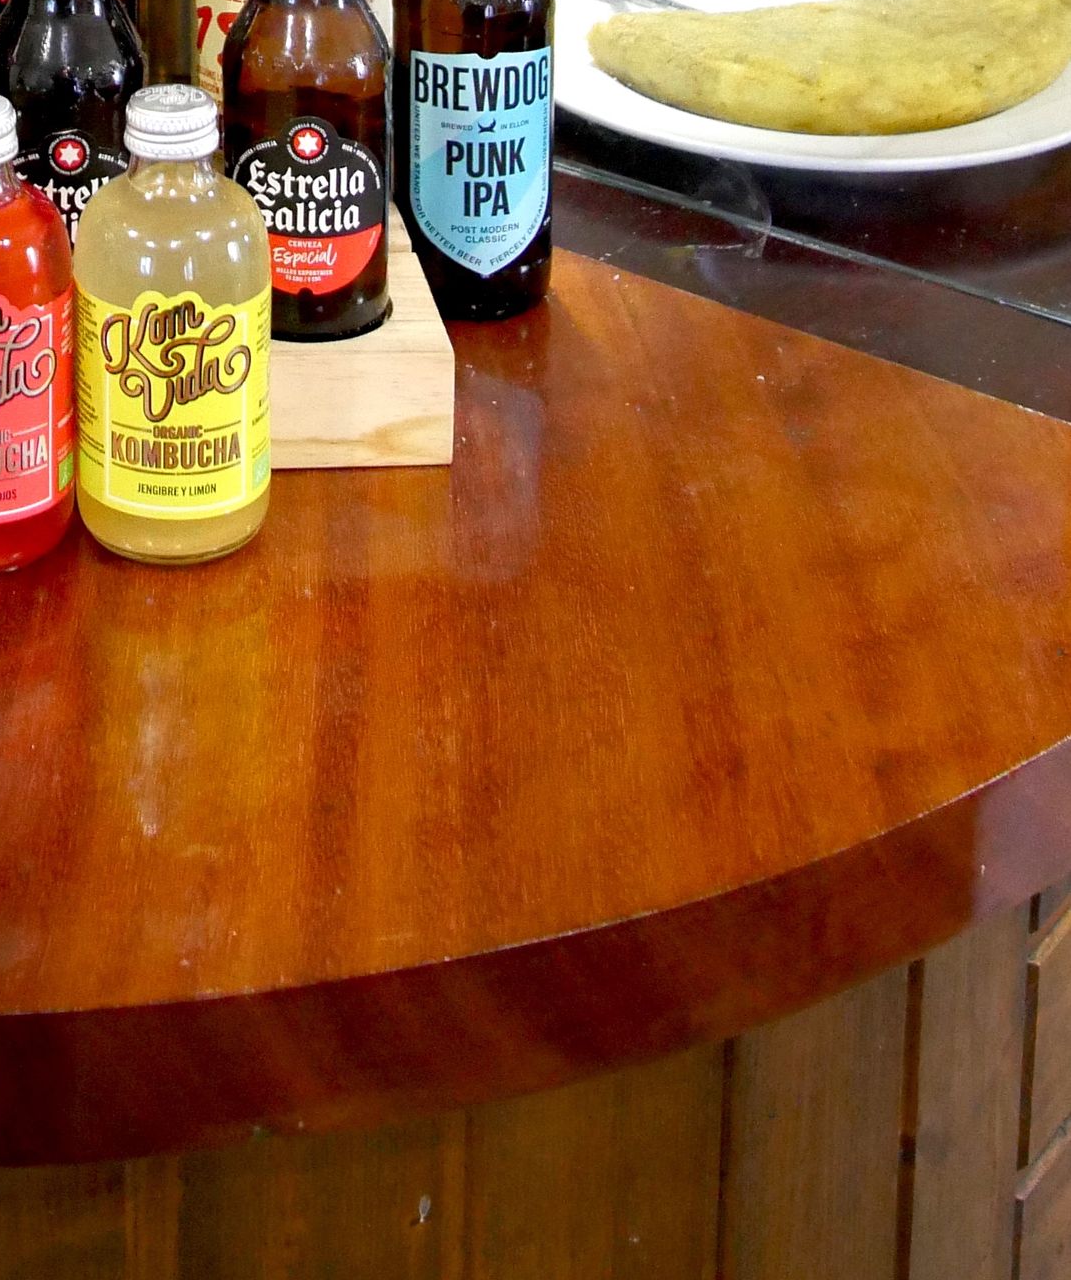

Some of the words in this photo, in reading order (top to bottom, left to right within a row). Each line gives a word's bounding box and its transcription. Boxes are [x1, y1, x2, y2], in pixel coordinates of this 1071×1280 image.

[414, 55, 548, 112] BREWDOG
[440, 121, 473, 132] BREWED
[446, 136, 526, 177] PUNK
[247, 159, 366, 200] Estrella
[463, 180, 510, 217] IPA
[288, 240, 322, 248] CERVEZA
[423, 219, 456, 254] BETTER
[457, 248, 483, 267] BEER
[450, 224, 477, 234] POST
[479, 222, 520, 233] MODERN
[465, 235, 507, 243] CLASSIC
[273, 243, 337, 267] Especial
[100, 300, 204, 378] Kom
[119, 313, 251, 423] Vida
[111, 432, 241, 469] KOMBUCHA
[152, 425, 203, 439] ORGANIC
[138, 482, 180, 496] JENGIBRE
[181, 486, 186, 496] Y
[188, 482, 217, 496] LIMÓN
